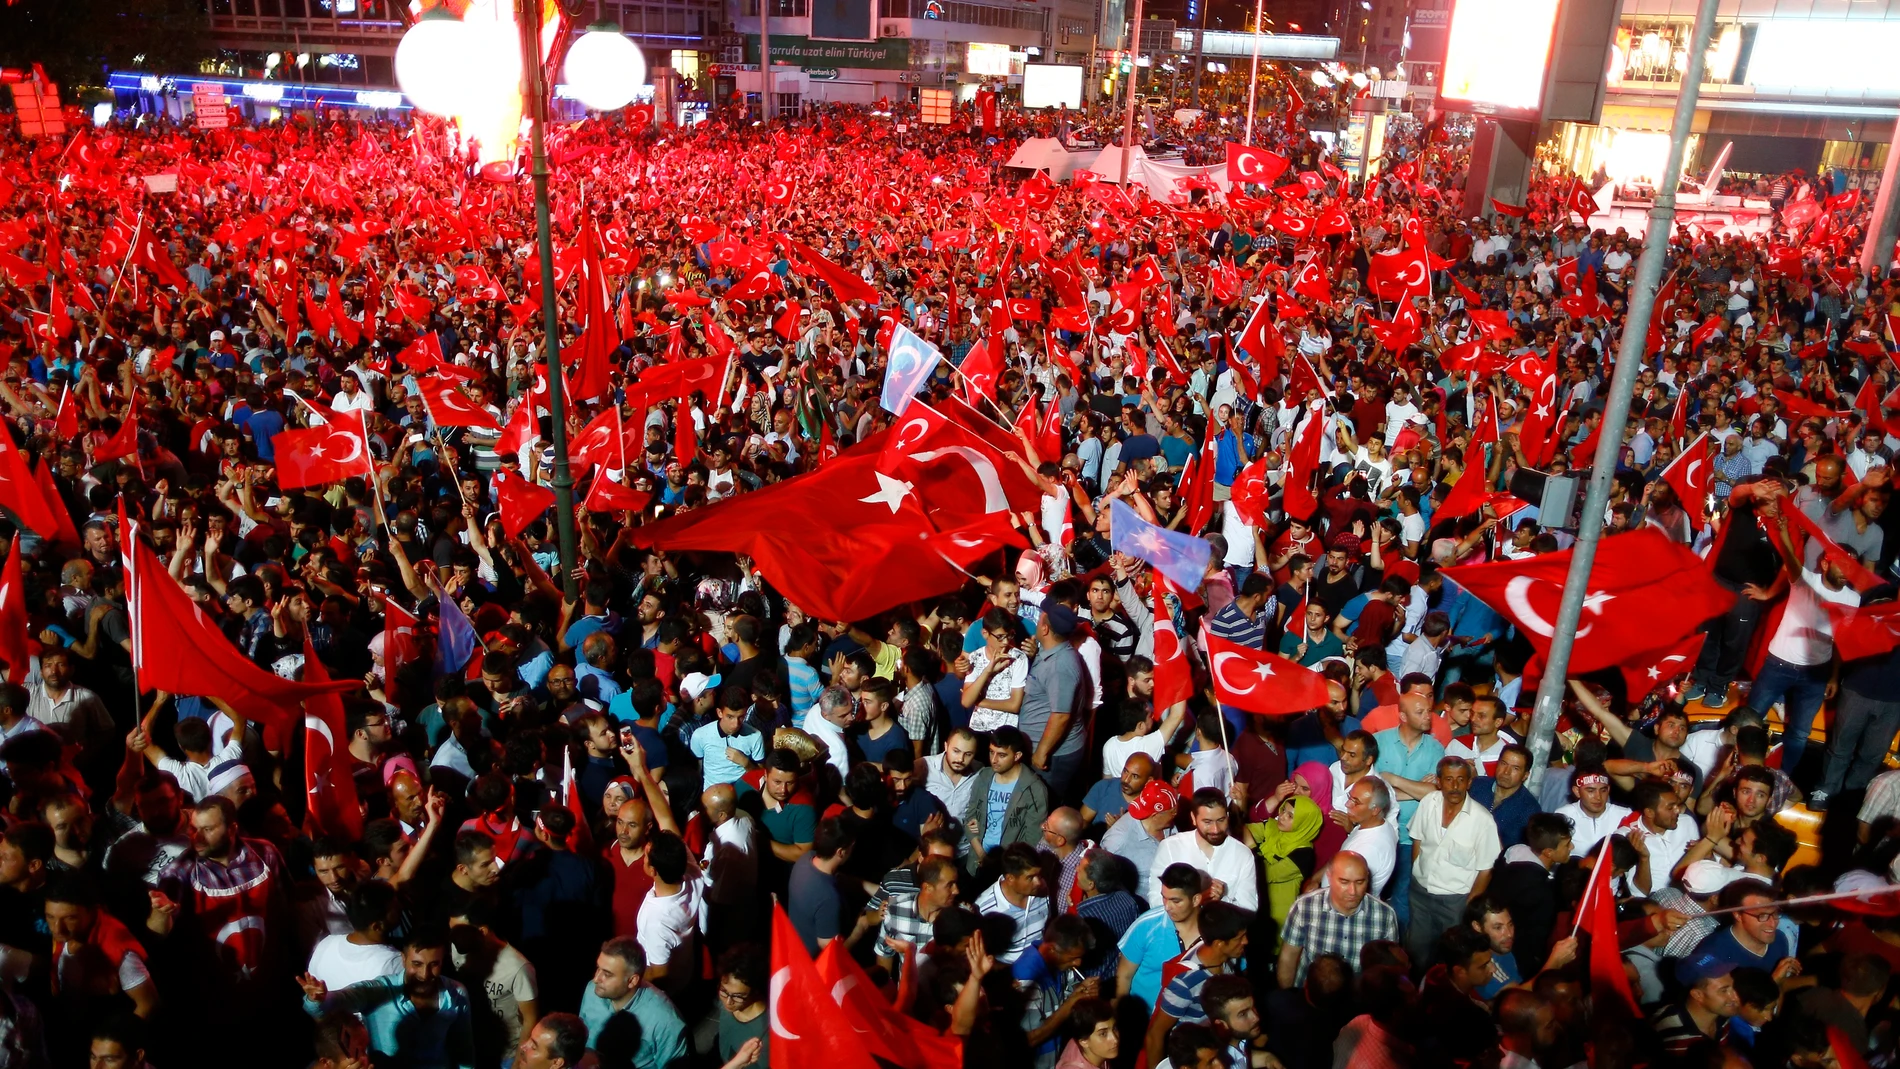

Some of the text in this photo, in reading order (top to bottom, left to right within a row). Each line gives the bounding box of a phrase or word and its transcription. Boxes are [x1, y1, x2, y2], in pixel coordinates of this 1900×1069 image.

[757, 44, 887, 61] Tsarrufa uzat elini Türkiye!
